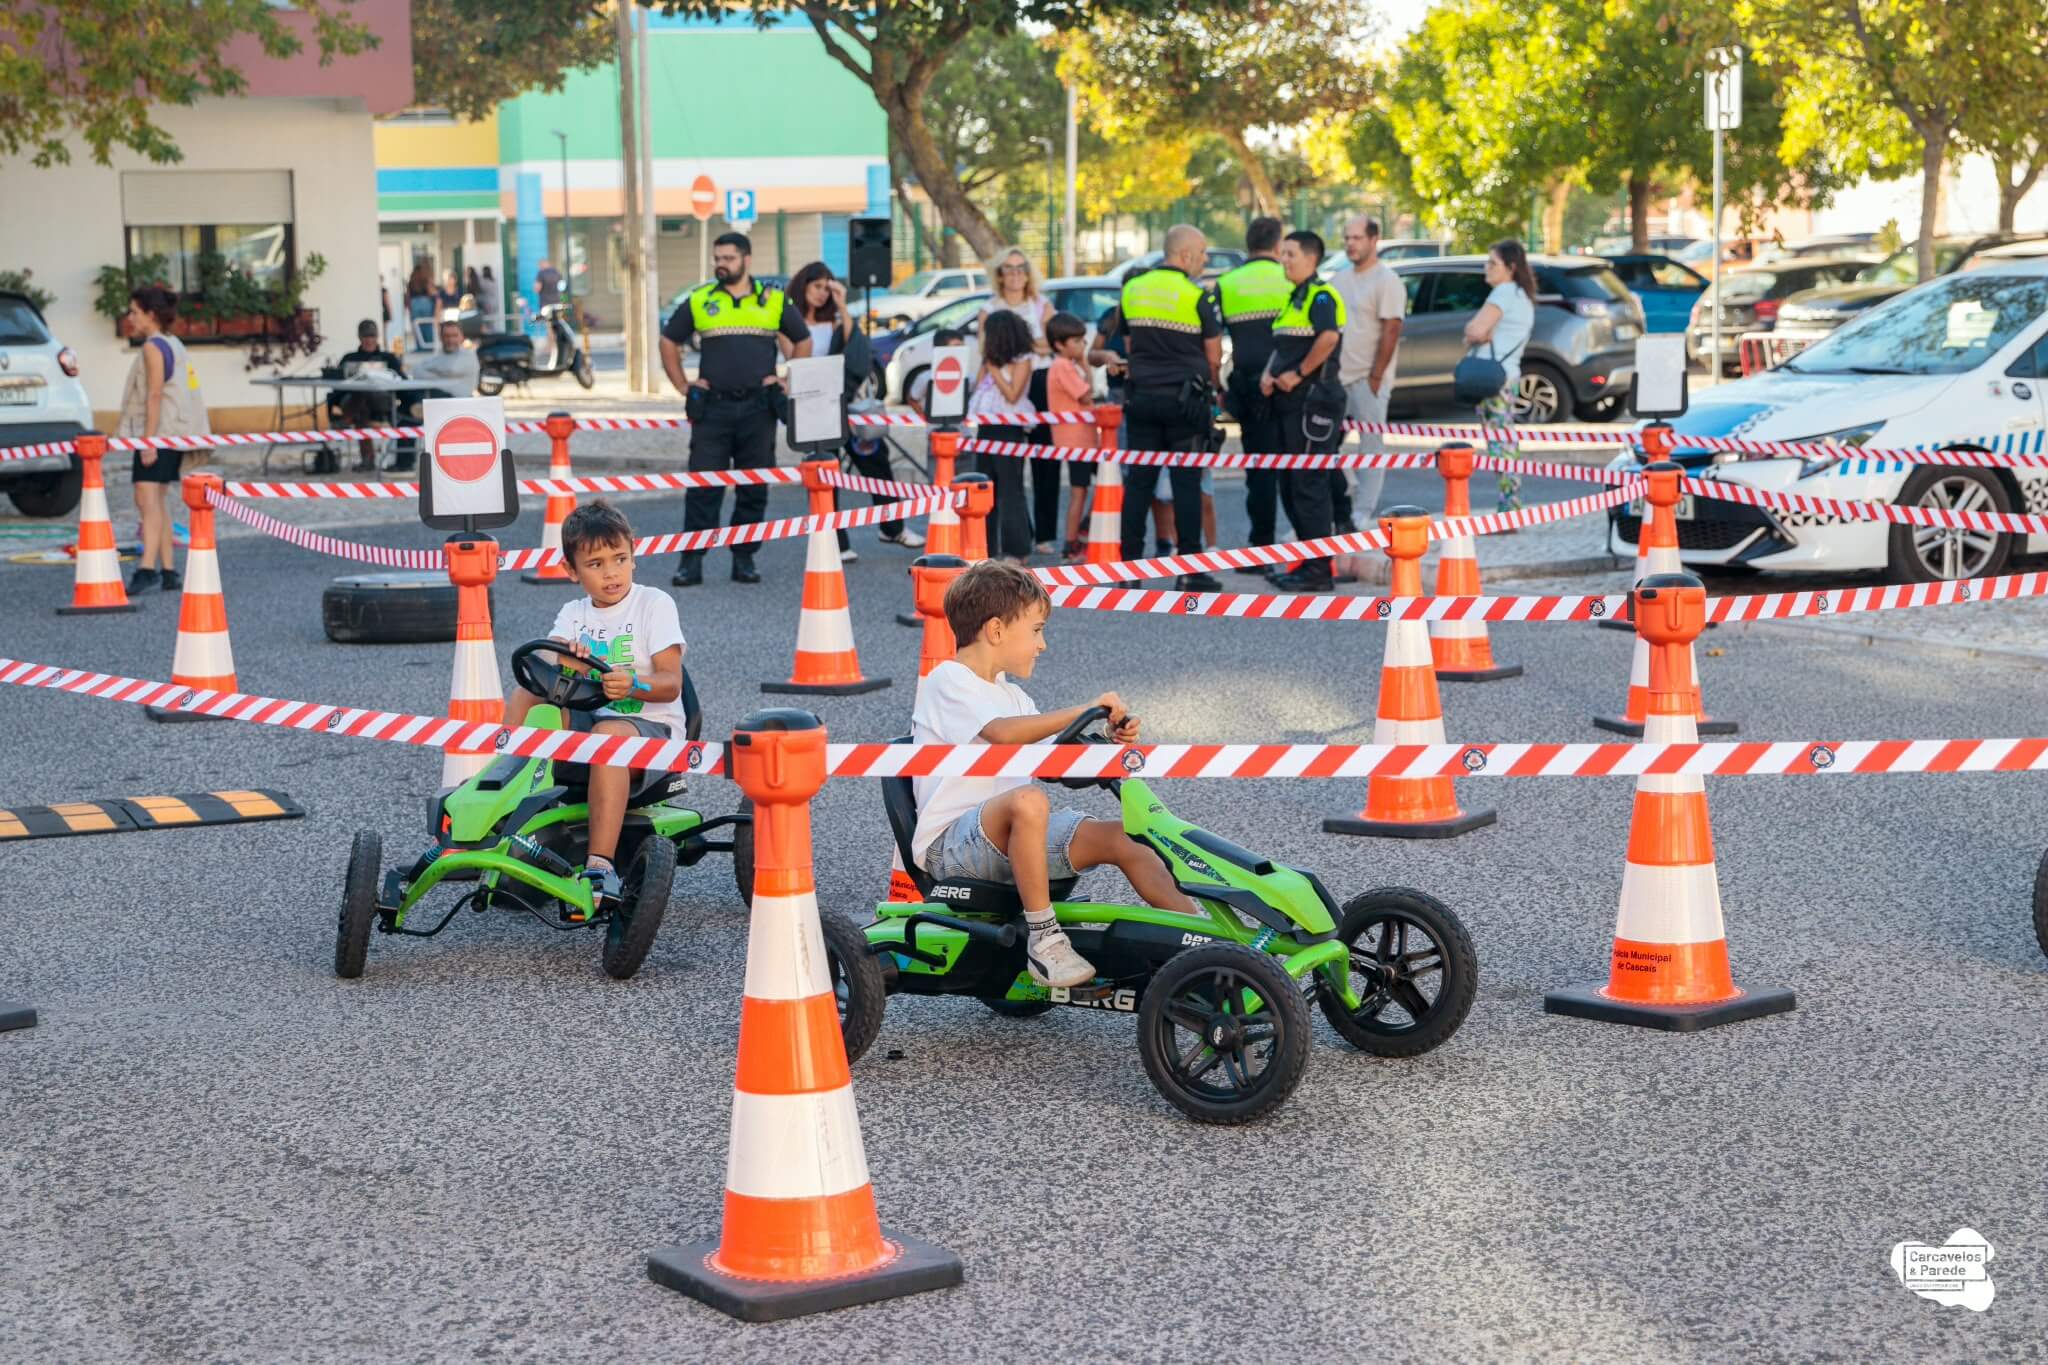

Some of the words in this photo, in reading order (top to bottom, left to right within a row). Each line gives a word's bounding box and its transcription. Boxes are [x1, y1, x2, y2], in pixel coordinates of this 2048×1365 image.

[732, 191, 750, 219] P
[930, 885, 972, 900] BERG
[1631, 950, 1672, 964] Municipal
[1626, 962, 1657, 973] Cascais
